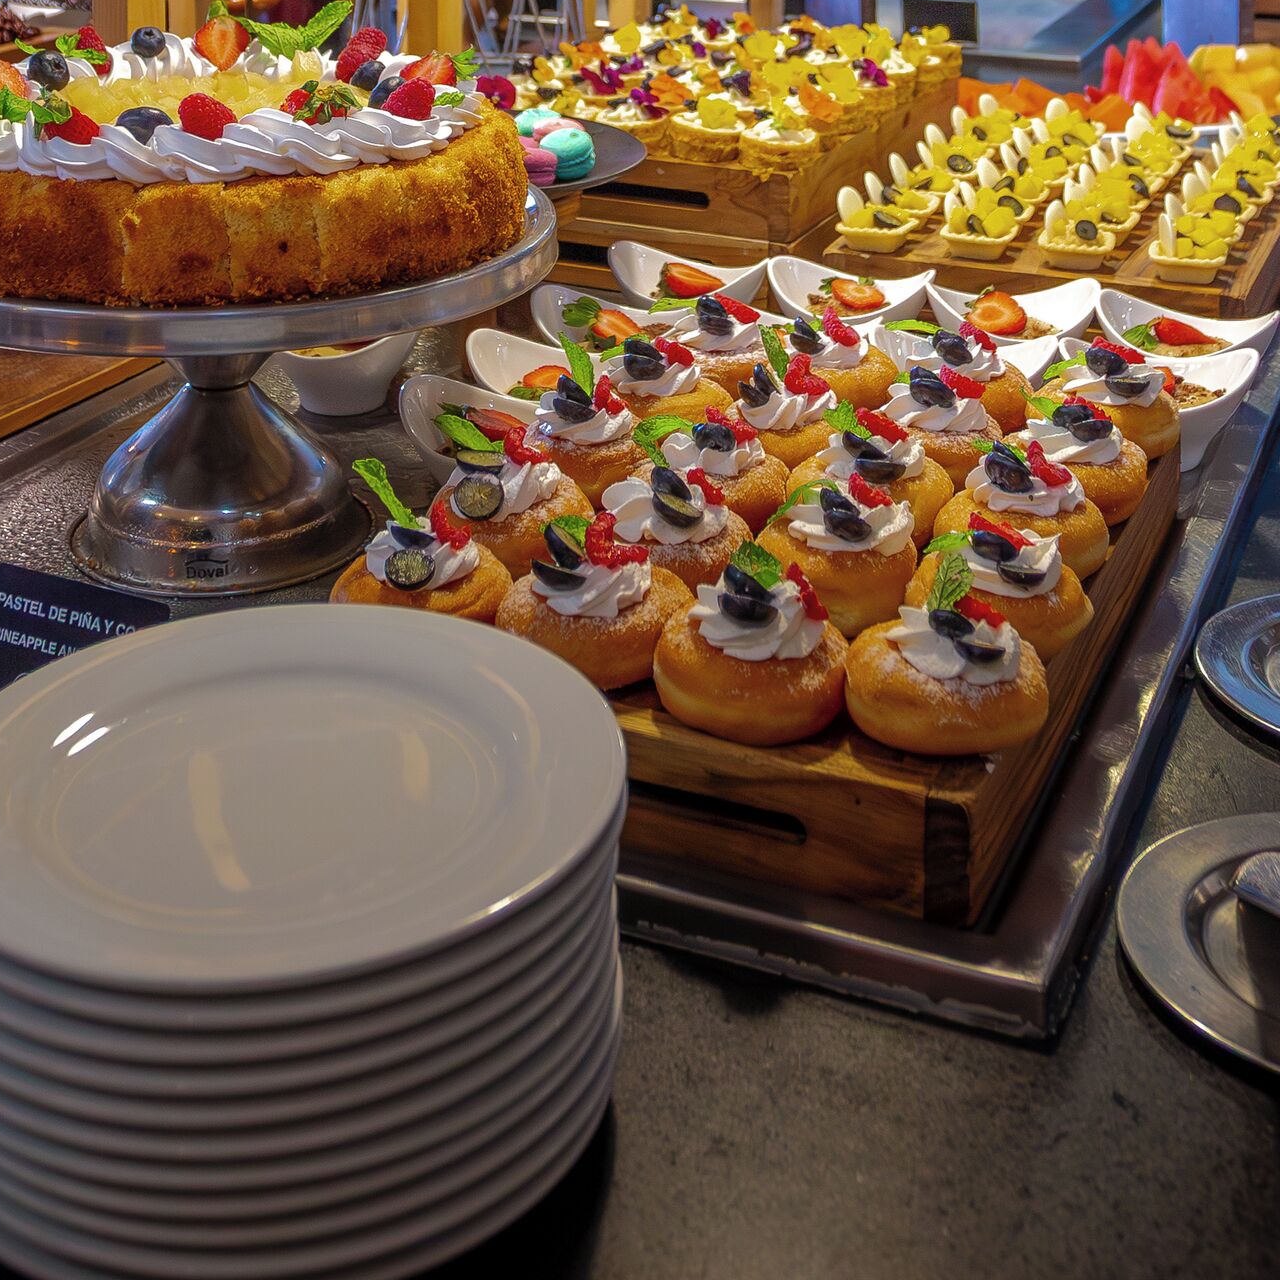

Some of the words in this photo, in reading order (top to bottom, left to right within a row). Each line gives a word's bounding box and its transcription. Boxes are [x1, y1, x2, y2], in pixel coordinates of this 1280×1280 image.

[186, 564, 229, 579] Doval
[48, 605, 68, 624] DE
[69, 611, 101, 633] PIÑA
[103, 618, 116, 635] Y
[115, 623, 136, 636] CO
[57, 644, 82, 657] AN
